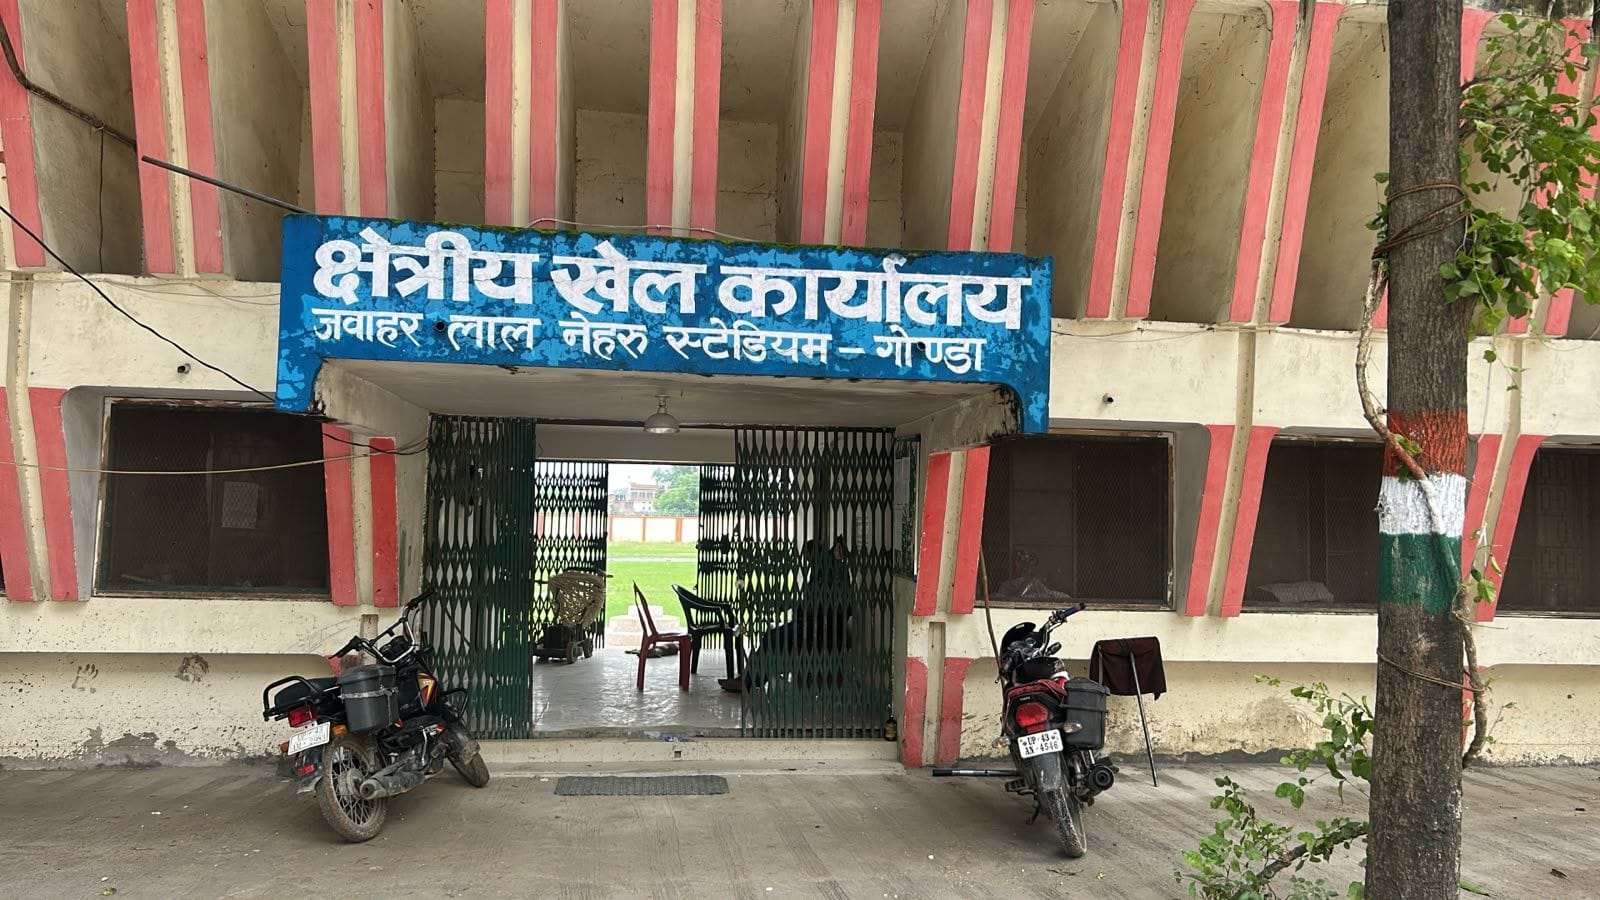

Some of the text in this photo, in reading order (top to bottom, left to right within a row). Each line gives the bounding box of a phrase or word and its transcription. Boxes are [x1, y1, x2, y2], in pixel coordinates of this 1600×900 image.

[313, 226, 1032, 330] क्षेत्रीय खेल कार्यालय
[311, 308, 424, 347] जवाहर
[447, 314, 542, 352] लाल
[662, 317, 833, 365] स्टेडियम
[873, 325, 988, 375] गोण्डा
